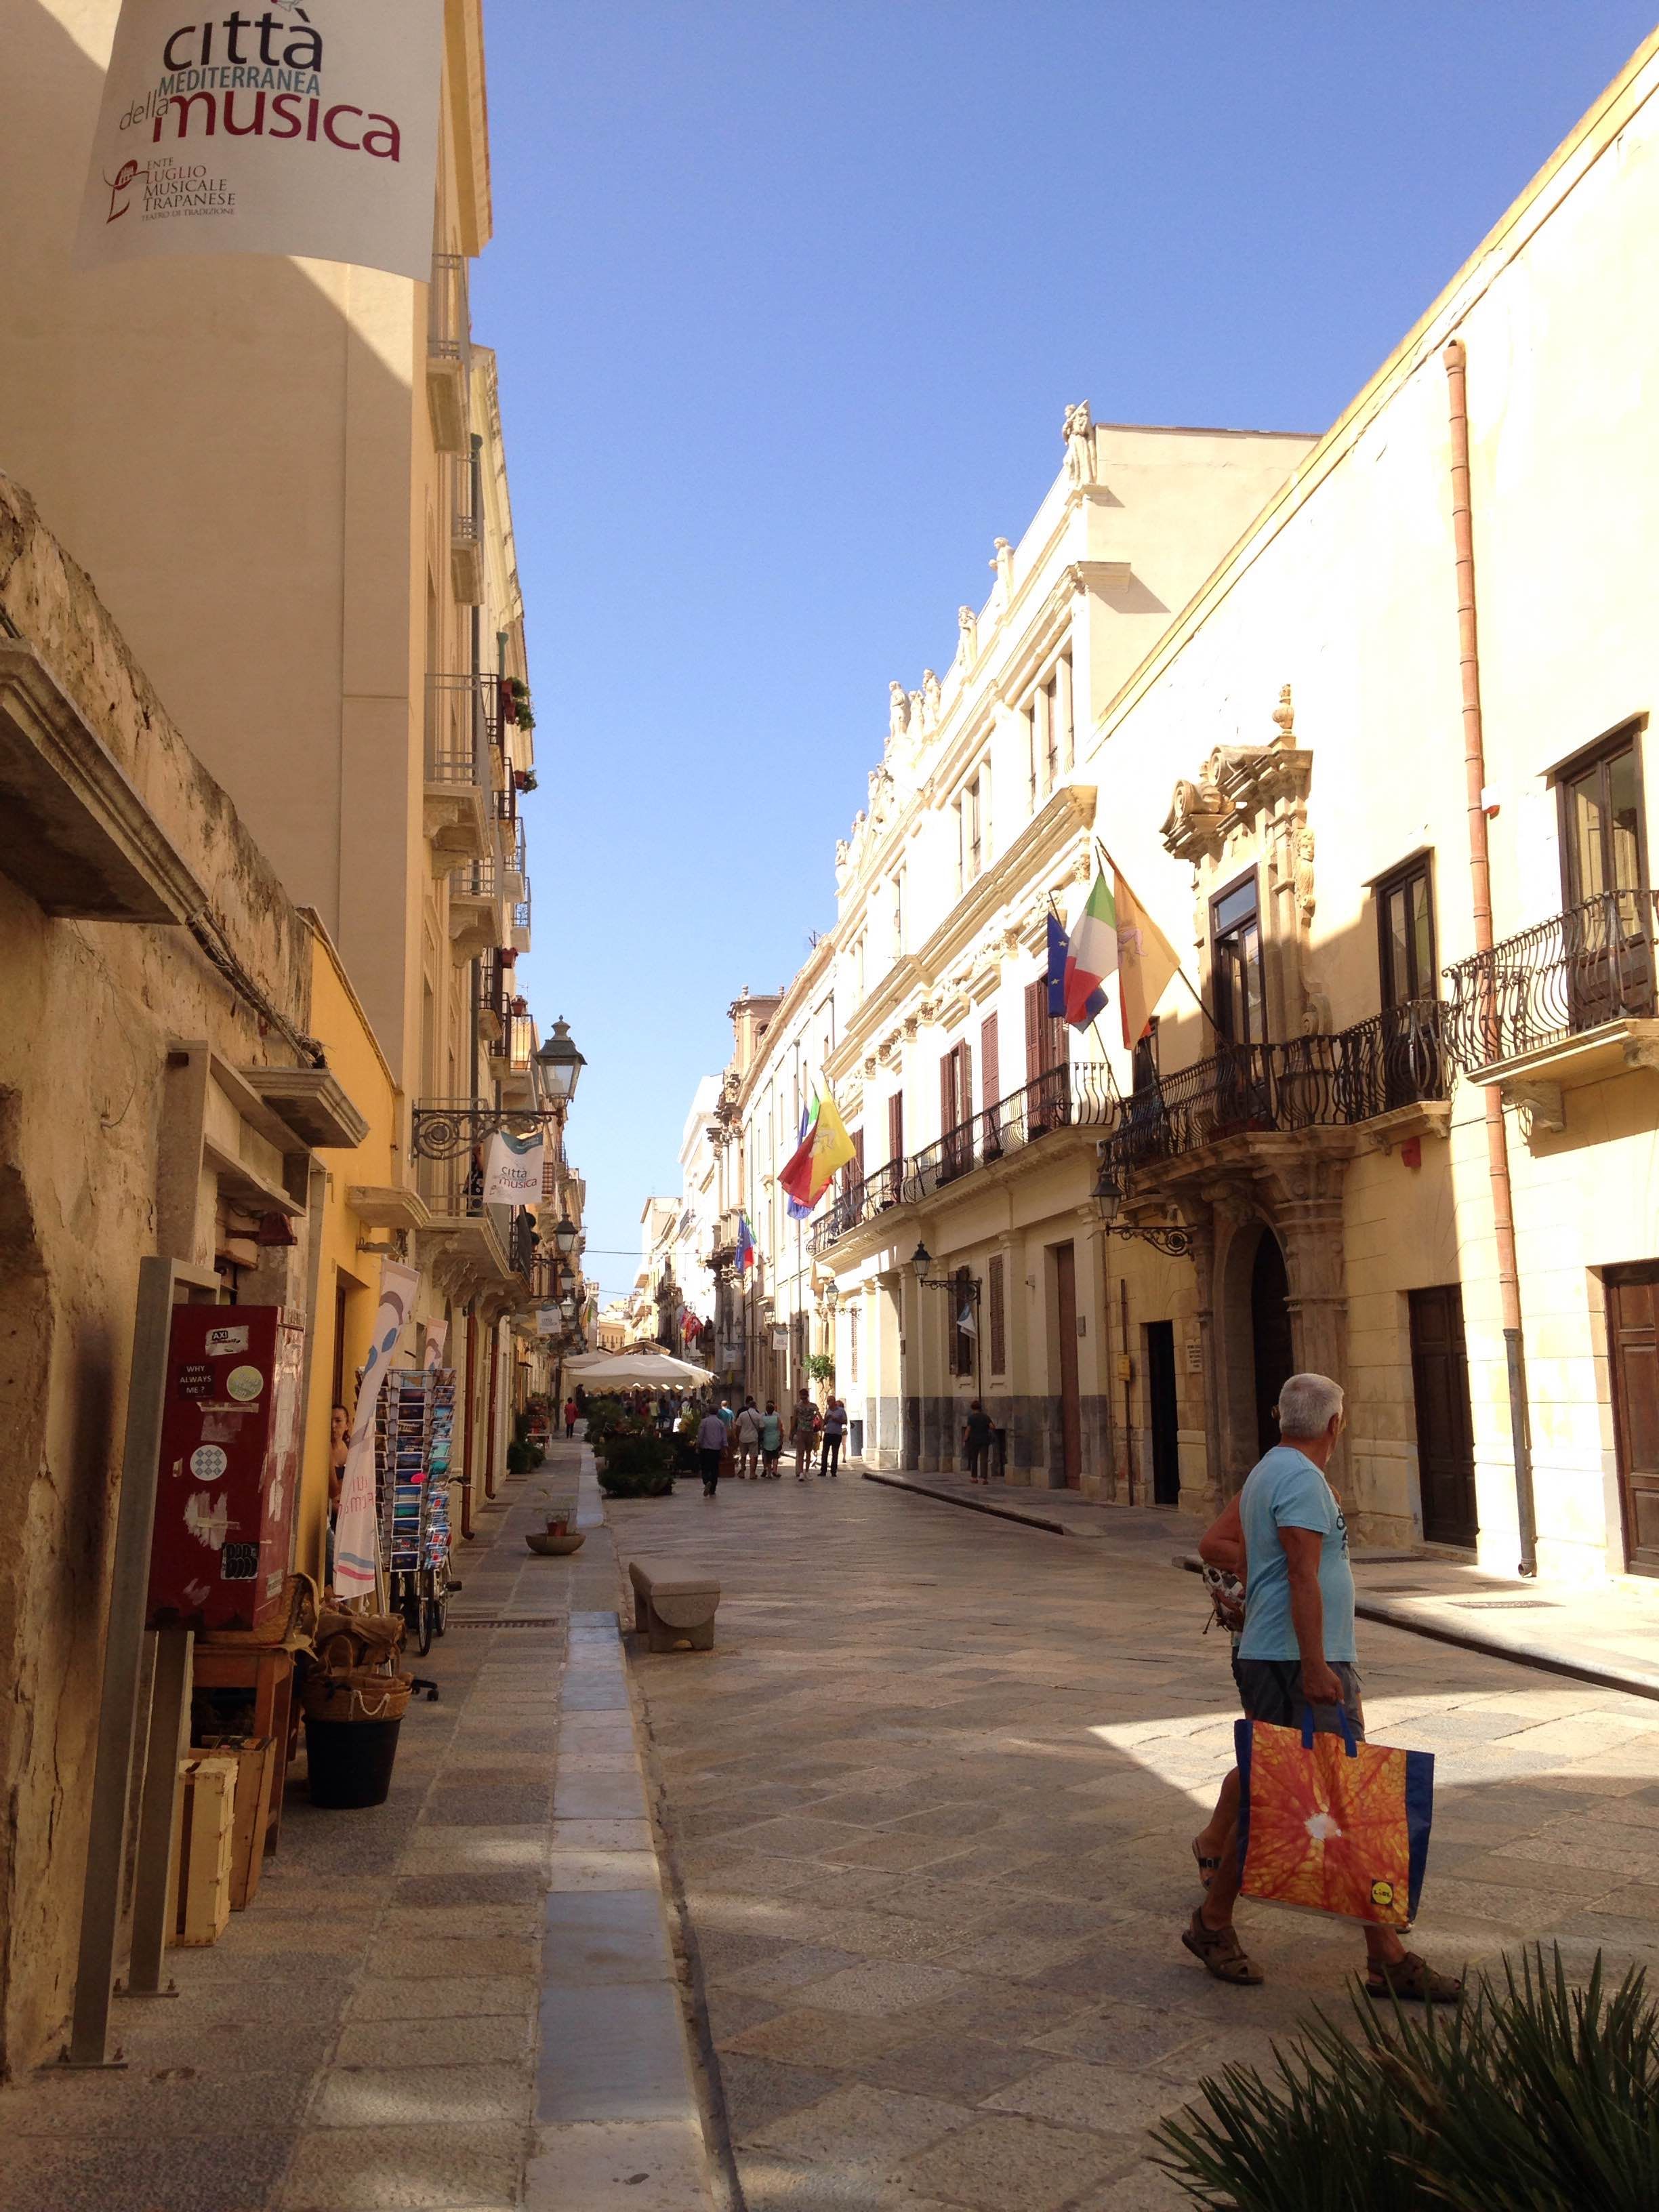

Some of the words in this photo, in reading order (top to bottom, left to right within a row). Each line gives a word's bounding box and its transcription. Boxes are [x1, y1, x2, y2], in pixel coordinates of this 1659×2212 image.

[163, 7, 323, 73] città
[158, 65, 321, 96] MEDITERRANEA
[119, 89, 169, 131] della
[152, 90, 401, 163] musica
[146, 164, 207, 184] LUGLIO
[147, 157, 173, 170] ENTE
[143, 178, 227, 201] MUSICALE
[144, 192, 236, 211] TRAPANESE
[499, 1177, 537, 1189] musica
[180, 1375, 211, 1383] ALWAYS
